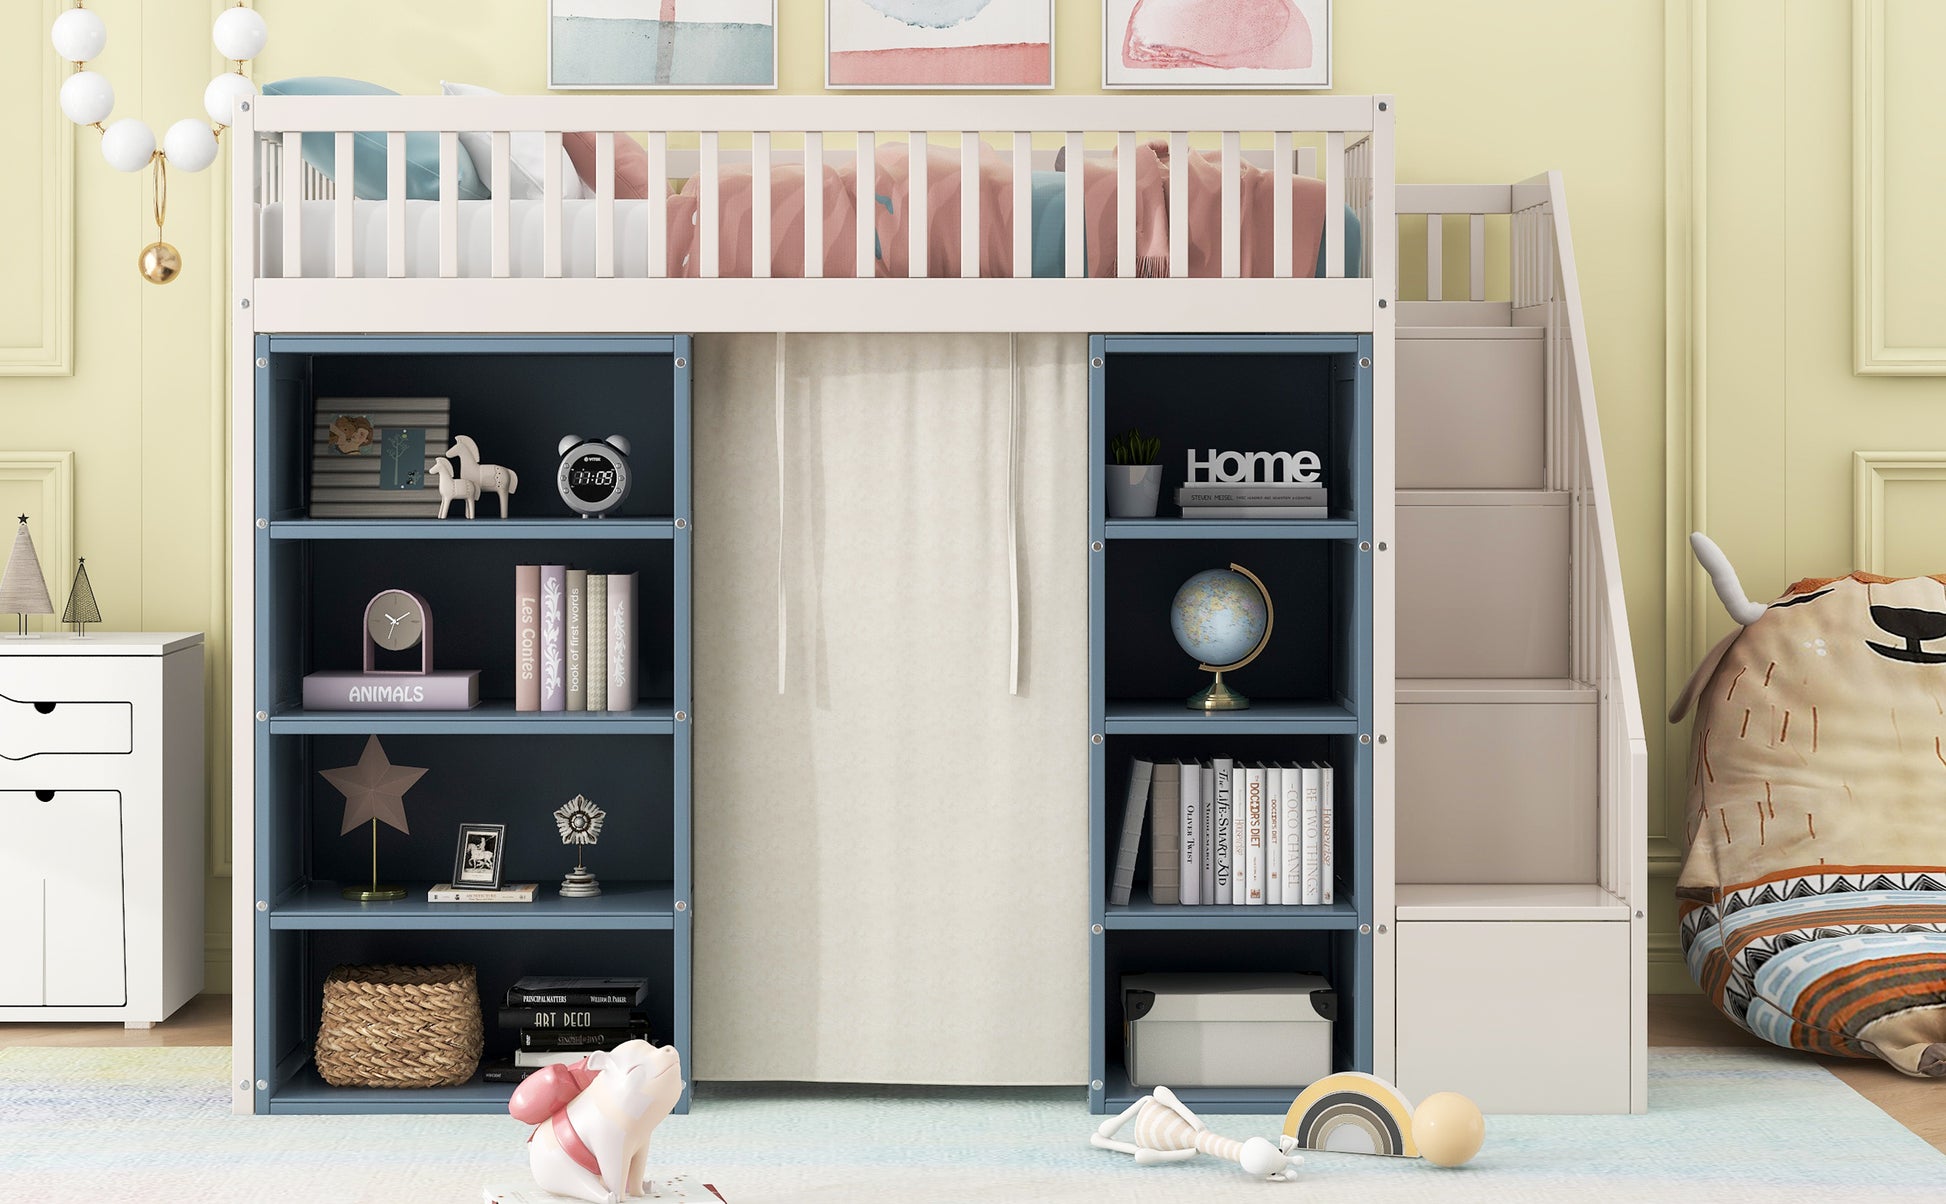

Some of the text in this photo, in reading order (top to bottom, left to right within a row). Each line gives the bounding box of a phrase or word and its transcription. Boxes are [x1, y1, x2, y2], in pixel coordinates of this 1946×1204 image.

[578, 471, 613, 485] 11:09
[1187, 449, 1321, 482] Home
[521, 597, 536, 680] Les Contes
[570, 588, 580, 692] book of first words
[348, 686, 425, 703] ANIMALS
[1306, 788, 1317, 802] BE
[1186, 805, 1196, 864] OLIVER TWIST
[1250, 828, 1261, 848] DIET
[1306, 806, 1318, 839] TWO
[1322, 808, 1332, 867] Housewise
[1287, 833, 1300, 888] CHANEL
[522, 995, 567, 1003] PRINCIPAL MATTERS
[534, 1012, 591, 1027] ART DECO
